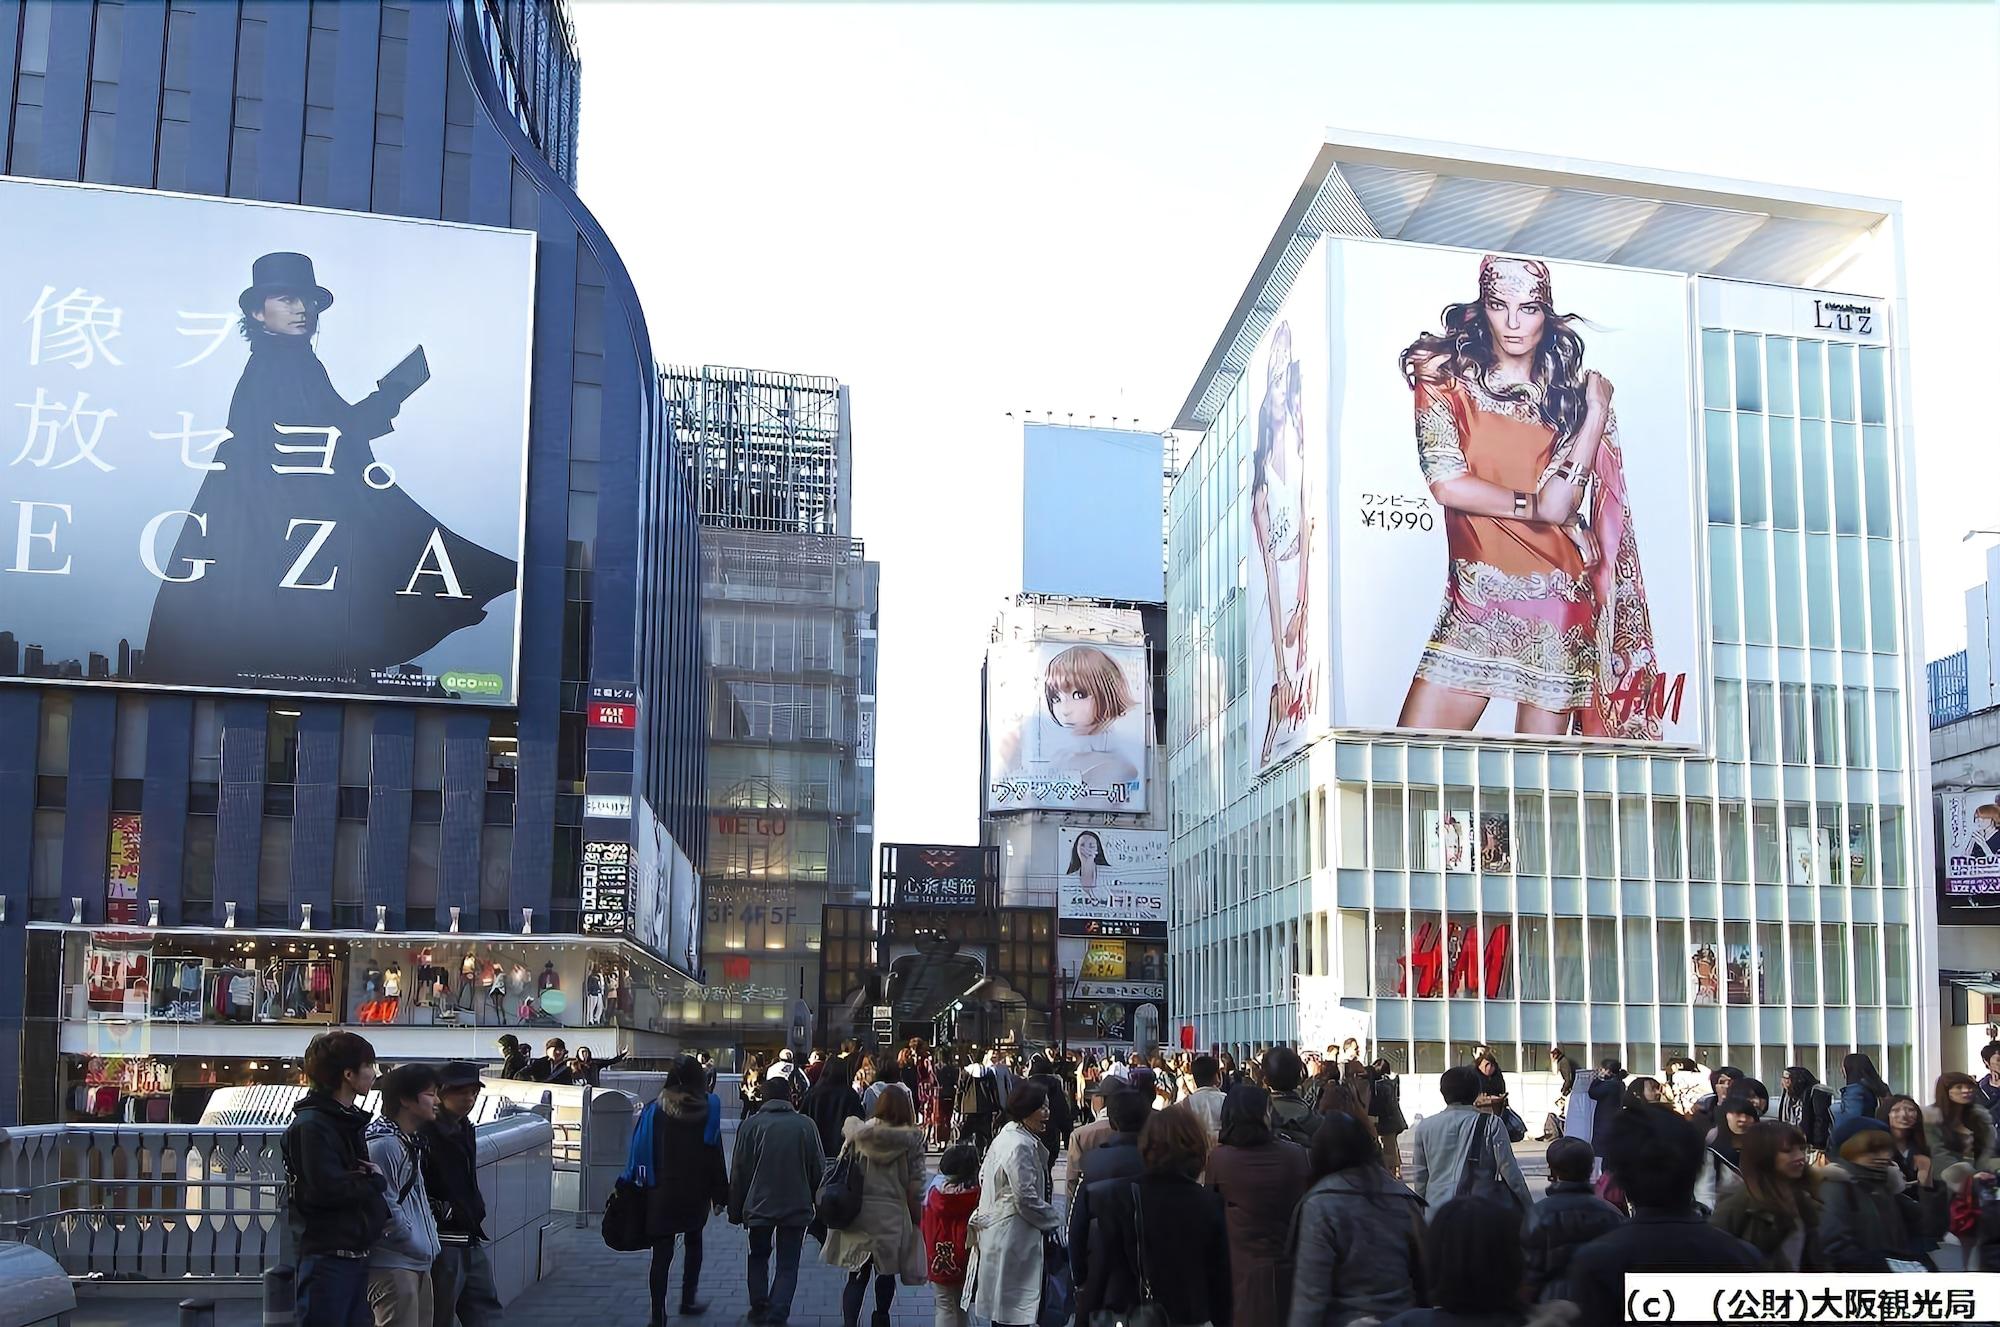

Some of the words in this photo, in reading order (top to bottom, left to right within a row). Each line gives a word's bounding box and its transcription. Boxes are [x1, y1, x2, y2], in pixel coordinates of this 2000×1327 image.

[1813, 300, 1872, 334] Luz
[1362, 494, 1430, 509] ワンピース
[1360, 509, 1433, 531] ¥1,990
